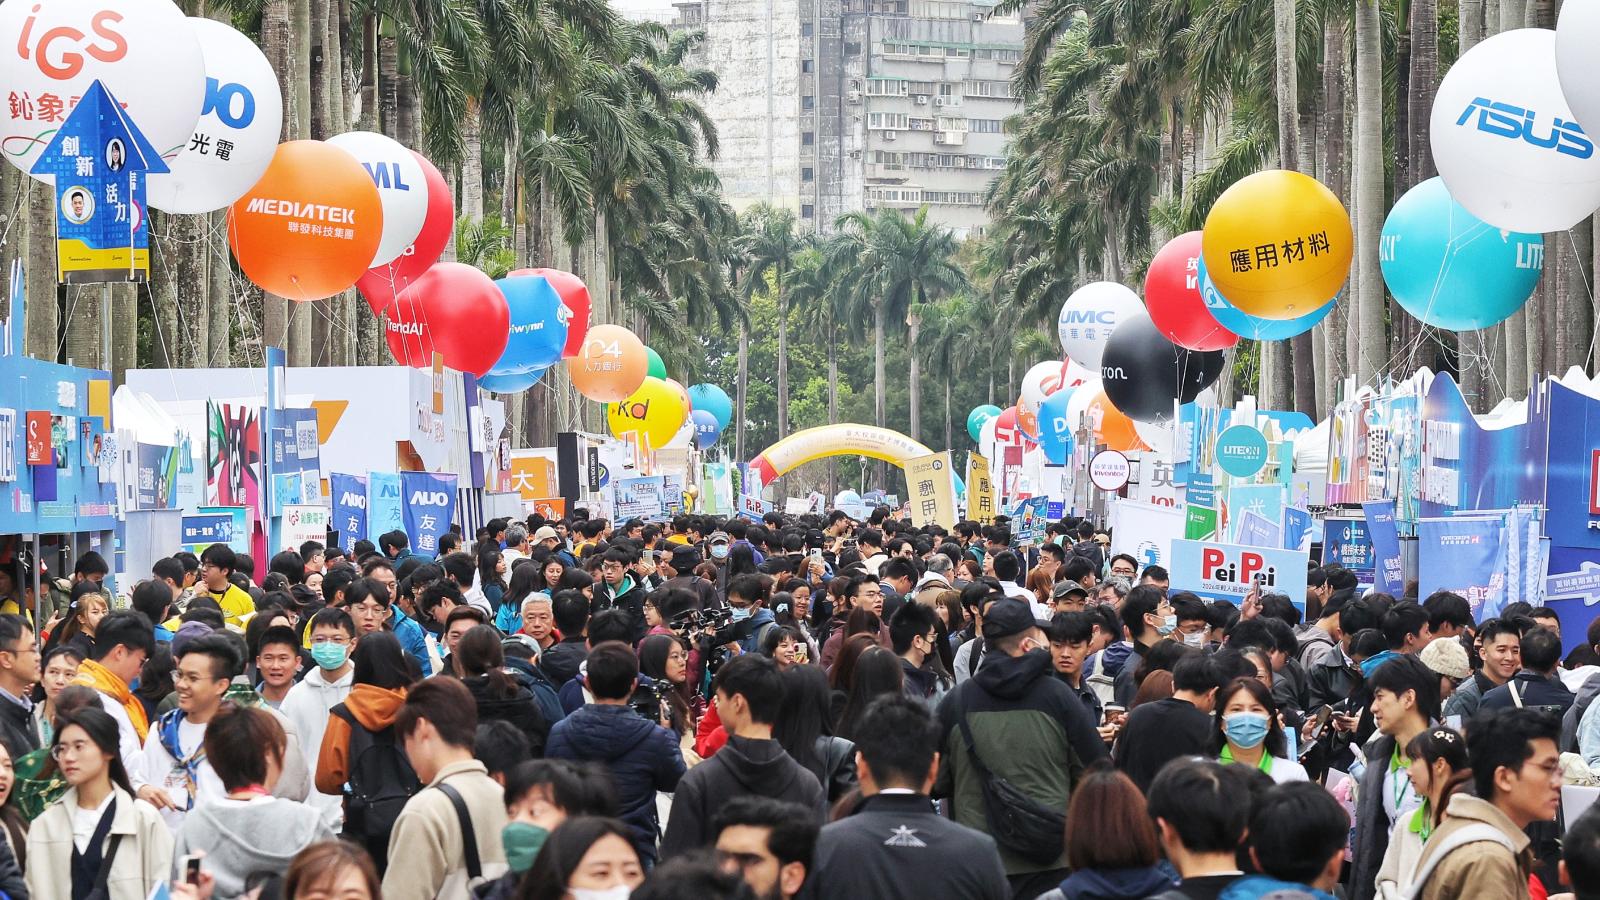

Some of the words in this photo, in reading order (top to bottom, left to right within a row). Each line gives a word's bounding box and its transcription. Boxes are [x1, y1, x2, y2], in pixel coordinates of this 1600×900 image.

[17, 4, 128, 81] iGS
[201, 77, 255, 129] UO
[1456, 97, 1595, 160] ASUS
[189, 133, 235, 161] 光電
[361, 162, 410, 191] ML
[106, 183, 126, 222] 活力
[246, 198, 355, 224] MEDIATEK
[287, 222, 354, 240] 聯發科技集團
[1229, 230, 1331, 274] 應用材料
[509, 320, 545, 334] iwynn
[1060, 311, 1115, 324] UMC
[512, 469, 535, 491] 大
[340, 491, 366, 510] AUO
[410, 490, 449, 507] AUO
[417, 514, 437, 551] 友達
